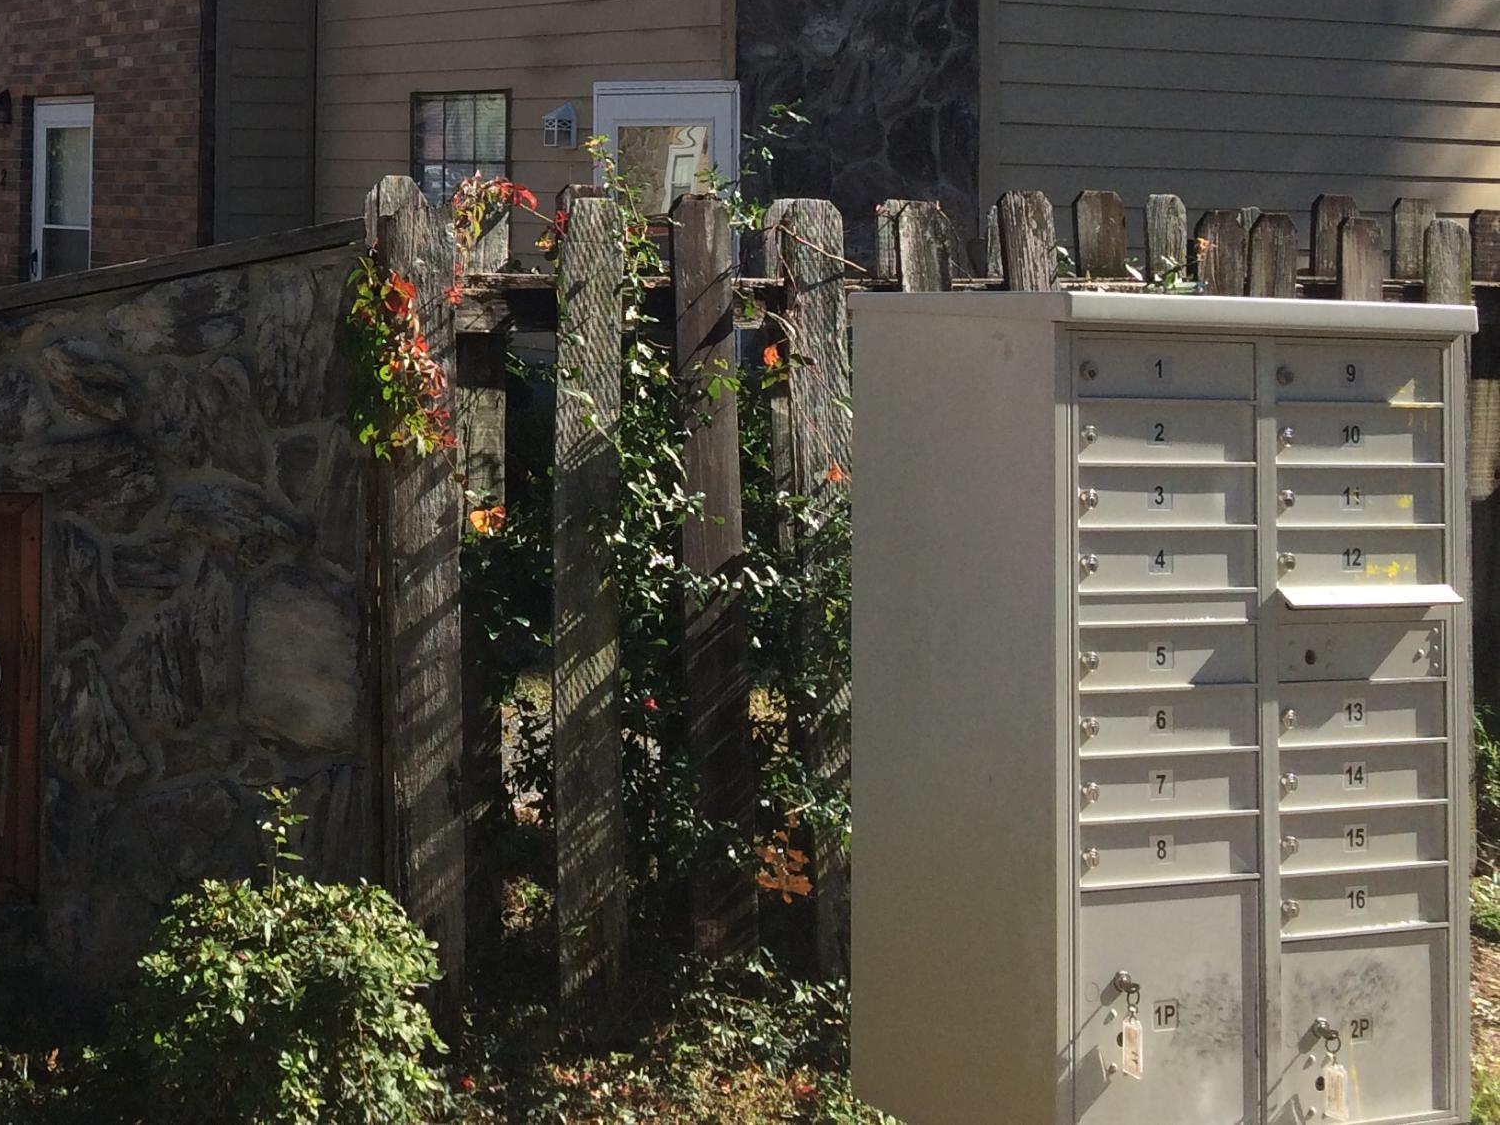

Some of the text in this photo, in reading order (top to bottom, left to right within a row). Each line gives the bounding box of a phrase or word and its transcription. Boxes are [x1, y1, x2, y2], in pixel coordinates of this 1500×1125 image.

[1154, 359, 1163, 379] 1
[1346, 363, 1357, 383] 9
[1154, 422, 1165, 442] 2
[1342, 425, 1360, 444] 10
[1154, 485, 1165, 506] 3
[1154, 549, 1166, 569] 4
[1343, 547, 1362, 567] 12
[1155, 646, 1167, 667] 5
[1155, 710, 1167, 730] 6
[1344, 702, 1364, 722] 13
[1155, 774, 1167, 794] 7
[1345, 765, 1364, 785] 14
[1346, 827, 1365, 848] 15
[1156, 839, 1167, 860] 8
[1347, 889, 1366, 910] 16
[1154, 1005, 1176, 1026] 1P
[1350, 1018, 1370, 1038] 2P
